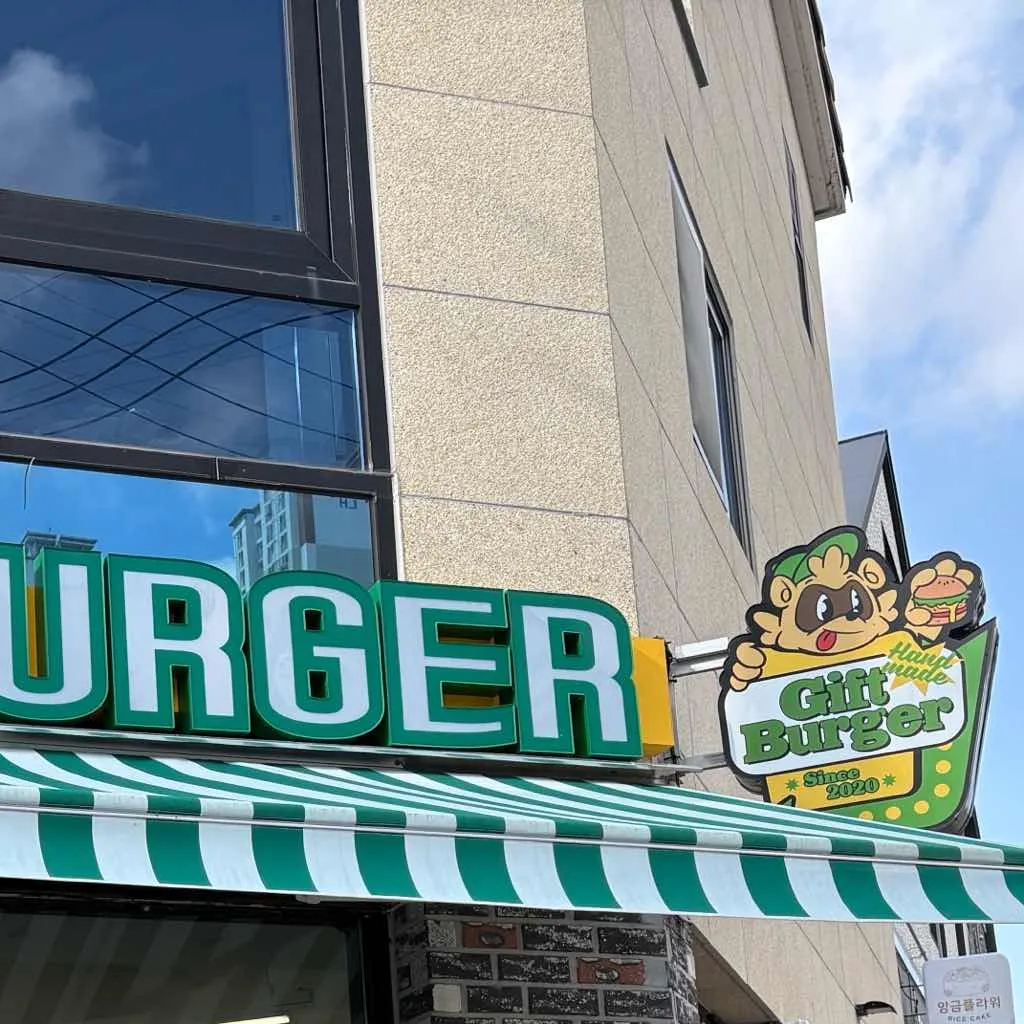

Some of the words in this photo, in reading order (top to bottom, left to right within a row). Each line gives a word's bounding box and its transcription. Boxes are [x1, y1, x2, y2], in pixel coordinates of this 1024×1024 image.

[779, 665, 890, 721] Gift
[740, 696, 954, 765] Burger
[803, 768, 860, 788] Since
[826, 777, 880, 800] 2020
[937, 995, 1001, 1014] 앙금플라워
